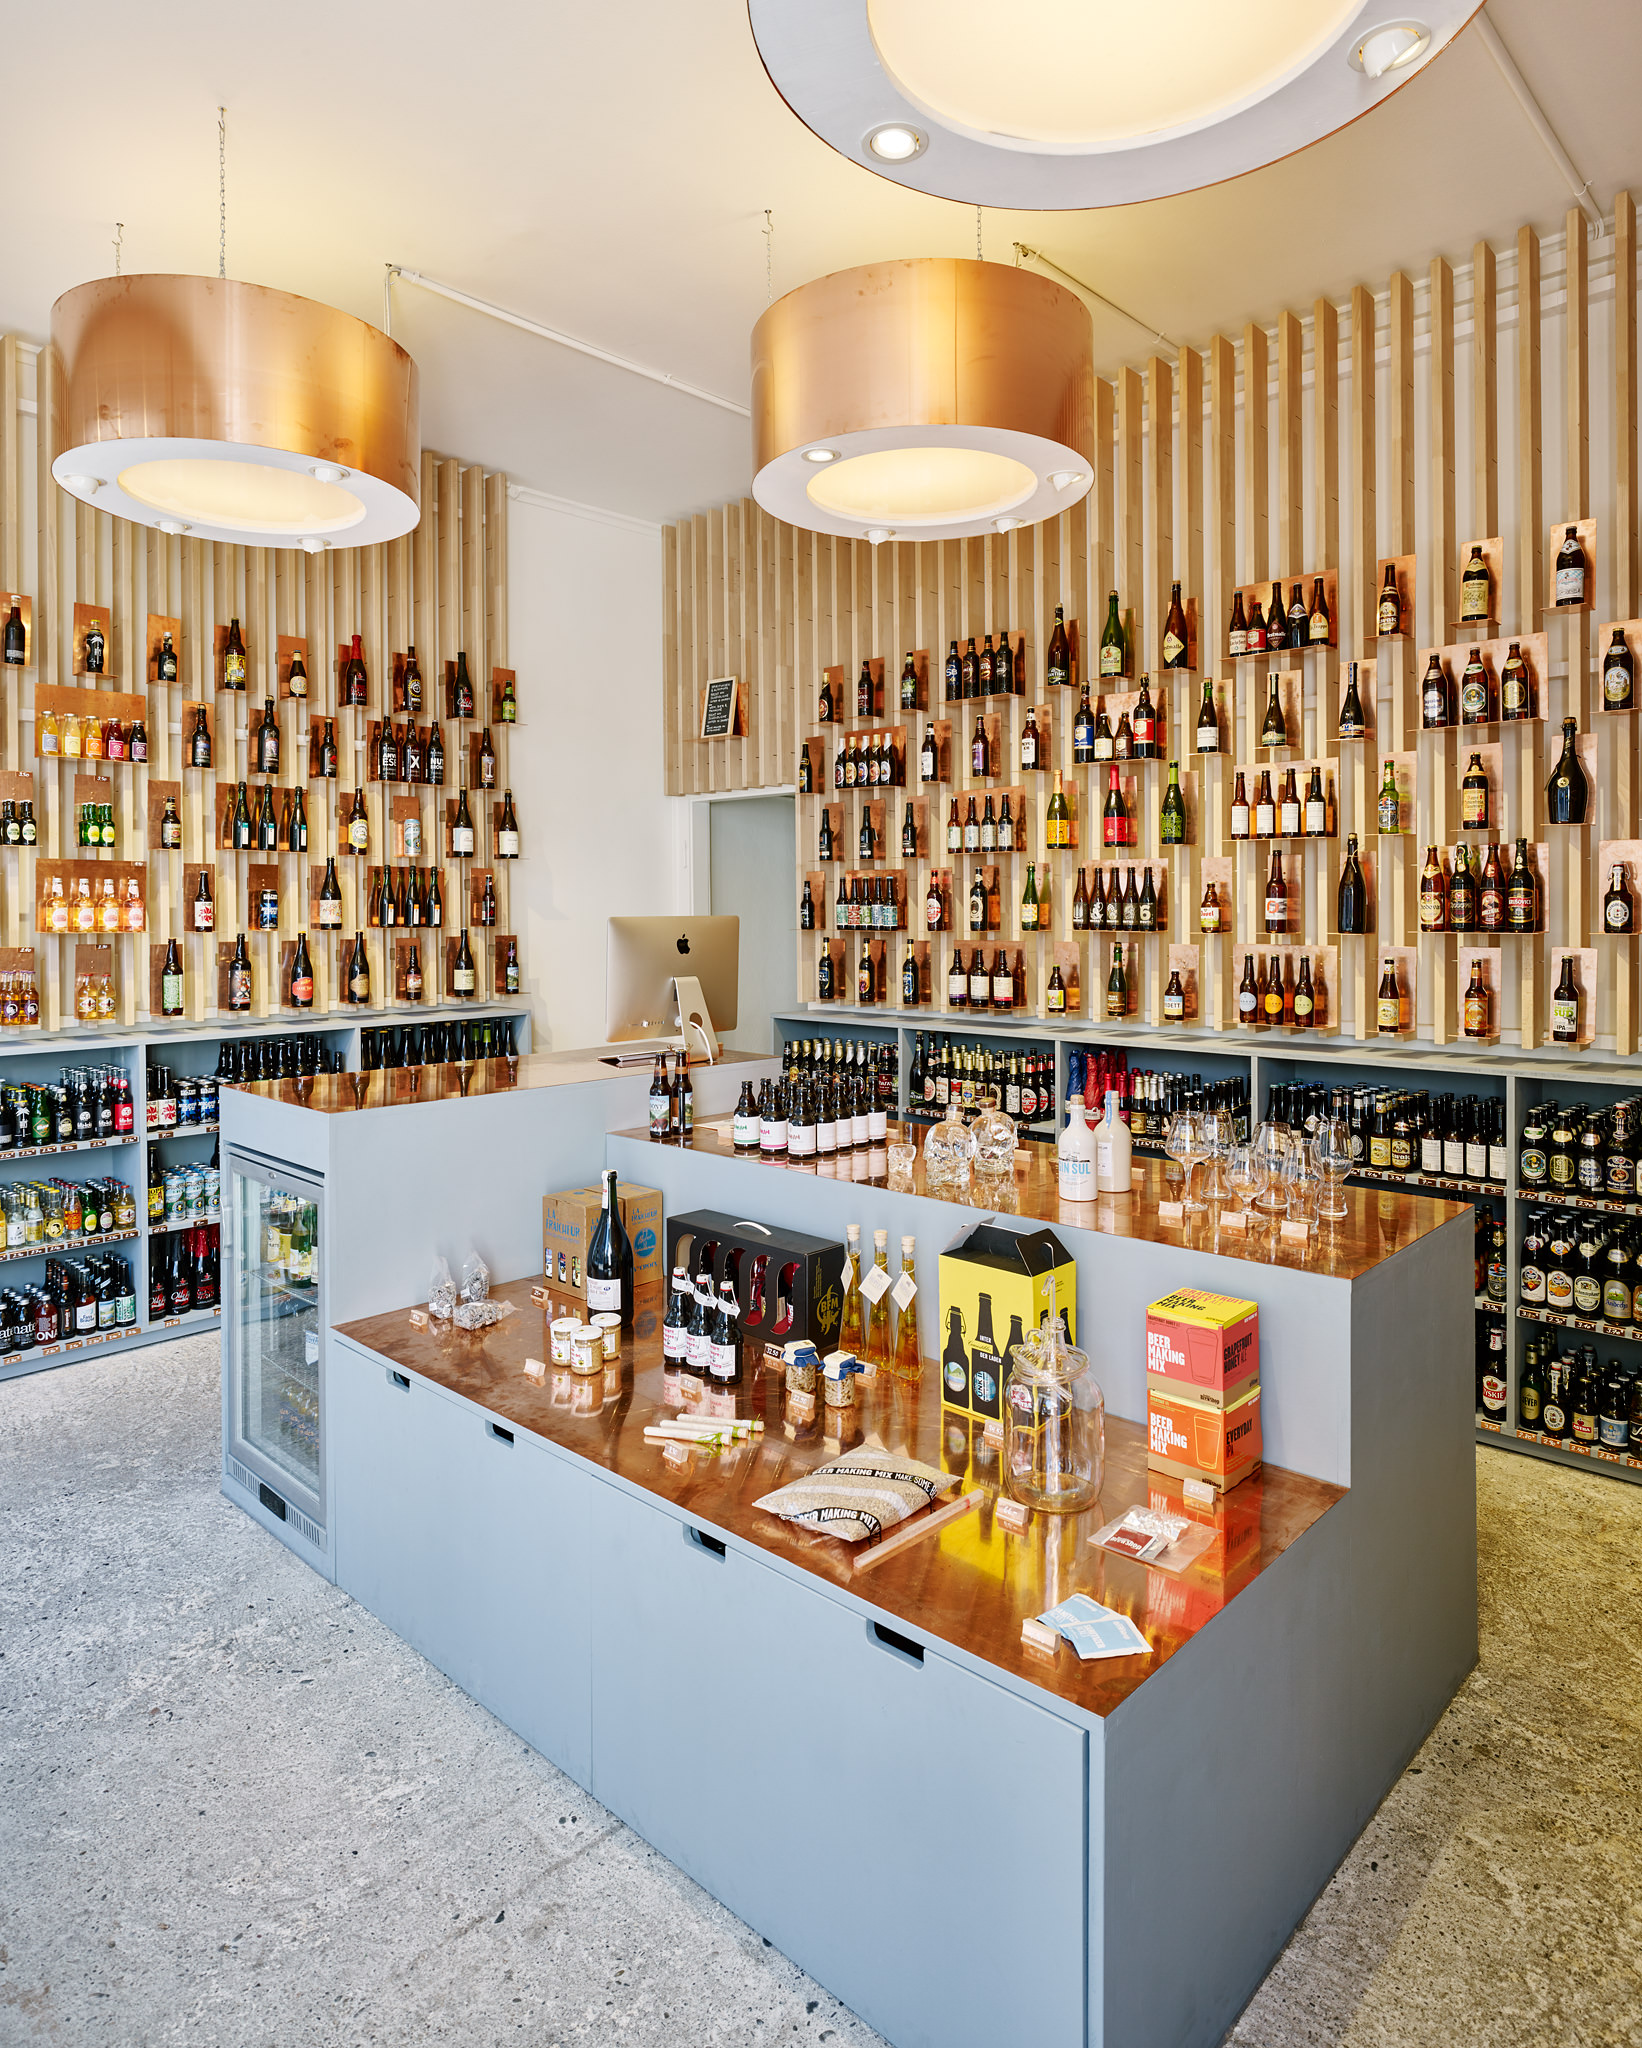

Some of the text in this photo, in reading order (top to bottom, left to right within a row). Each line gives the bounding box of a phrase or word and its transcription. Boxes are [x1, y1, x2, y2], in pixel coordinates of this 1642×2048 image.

[410, 755, 420, 769] X
[1071, 1162, 1091, 1175] SUL
[548, 1207, 556, 1220] LA
[821, 1297, 839, 1311] BFM
[1156, 1300, 1178, 1309] MIX
[1163, 1298, 1206, 1311] MAKING
[1168, 1294, 1197, 1303] BEER
[1148, 1331, 1171, 1350] BEER
[1224, 1332, 1253, 1361] GRAPEFRUIT
[979, 1351, 1002, 1364] DER LADEN
[1148, 1344, 1185, 1366] MAKING
[1148, 1356, 1166, 1374] MIX
[1224, 1355, 1240, 1374] HONEY
[1483, 1388, 1504, 1400] TYSKIE
[1150, 1412, 1173, 1432] BEER
[1150, 1424, 1188, 1449] MAKING
[1226, 1418, 1253, 1445] EVERYDAY
[1150, 1438, 1168, 1456] MIX
[1226, 1443, 1234, 1458] IPA
[836, 1468, 872, 1476] MAKING
[874, 1470, 893, 1479] MIX
[895, 1472, 912, 1482] MAKE
[913, 1476, 932, 1492] SOME
[820, 1507, 858, 1520] MAKING
[859, 1511, 879, 1530] MIX
